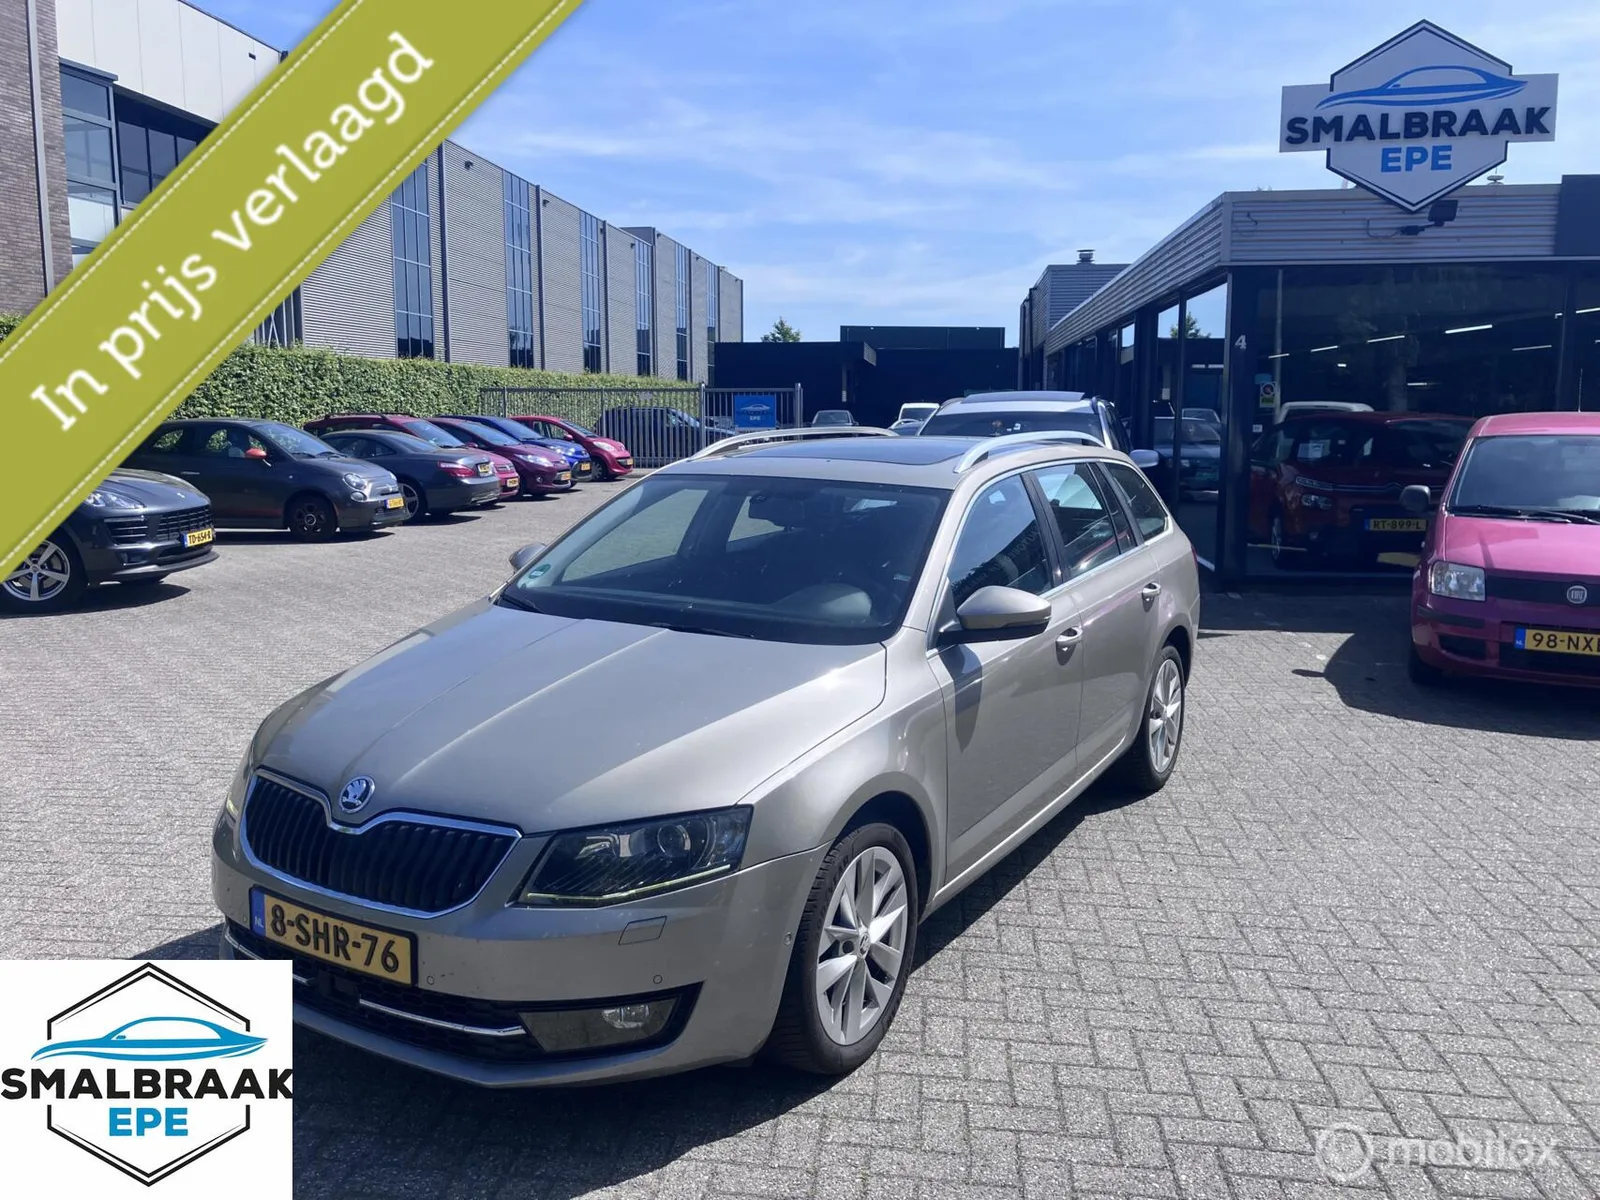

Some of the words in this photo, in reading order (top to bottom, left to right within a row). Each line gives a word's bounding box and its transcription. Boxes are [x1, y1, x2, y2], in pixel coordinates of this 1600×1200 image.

[1285, 106, 1552, 146] SMALBRAAK
[1380, 145, 1452, 173] EPE
[1235, 335, 1247, 349] 4
[1373, 520, 1420, 530] RT-899-L
[254, 916, 264, 929] NL
[270, 903, 400, 974] 8-SHR-76
